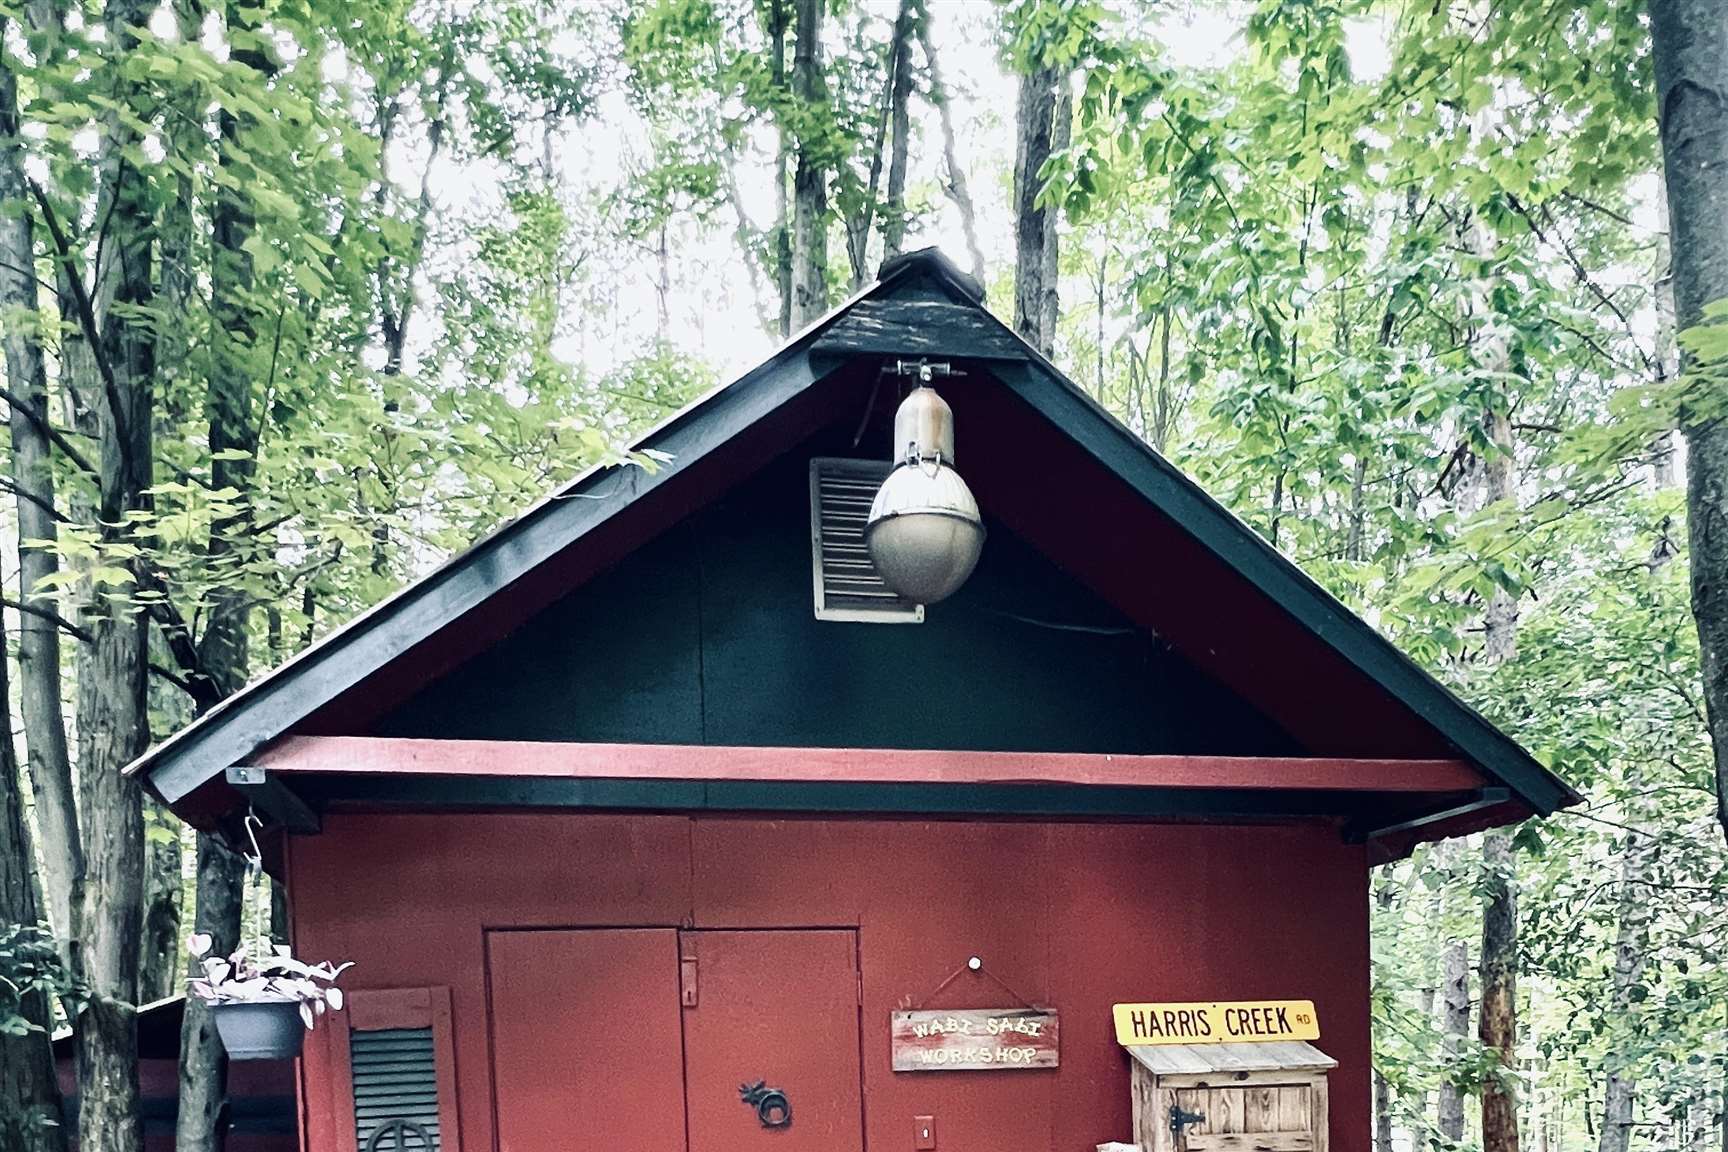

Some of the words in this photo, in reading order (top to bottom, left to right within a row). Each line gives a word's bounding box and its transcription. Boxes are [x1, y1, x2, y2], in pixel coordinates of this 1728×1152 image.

[912, 1016, 973, 1038] WABI
[1131, 1009, 1212, 1038] HARRIS
[1225, 1007, 1293, 1036] CREEK
[1295, 1014, 1311, 1025] RD
[920, 1047, 1037, 1064] WORKSHOP
